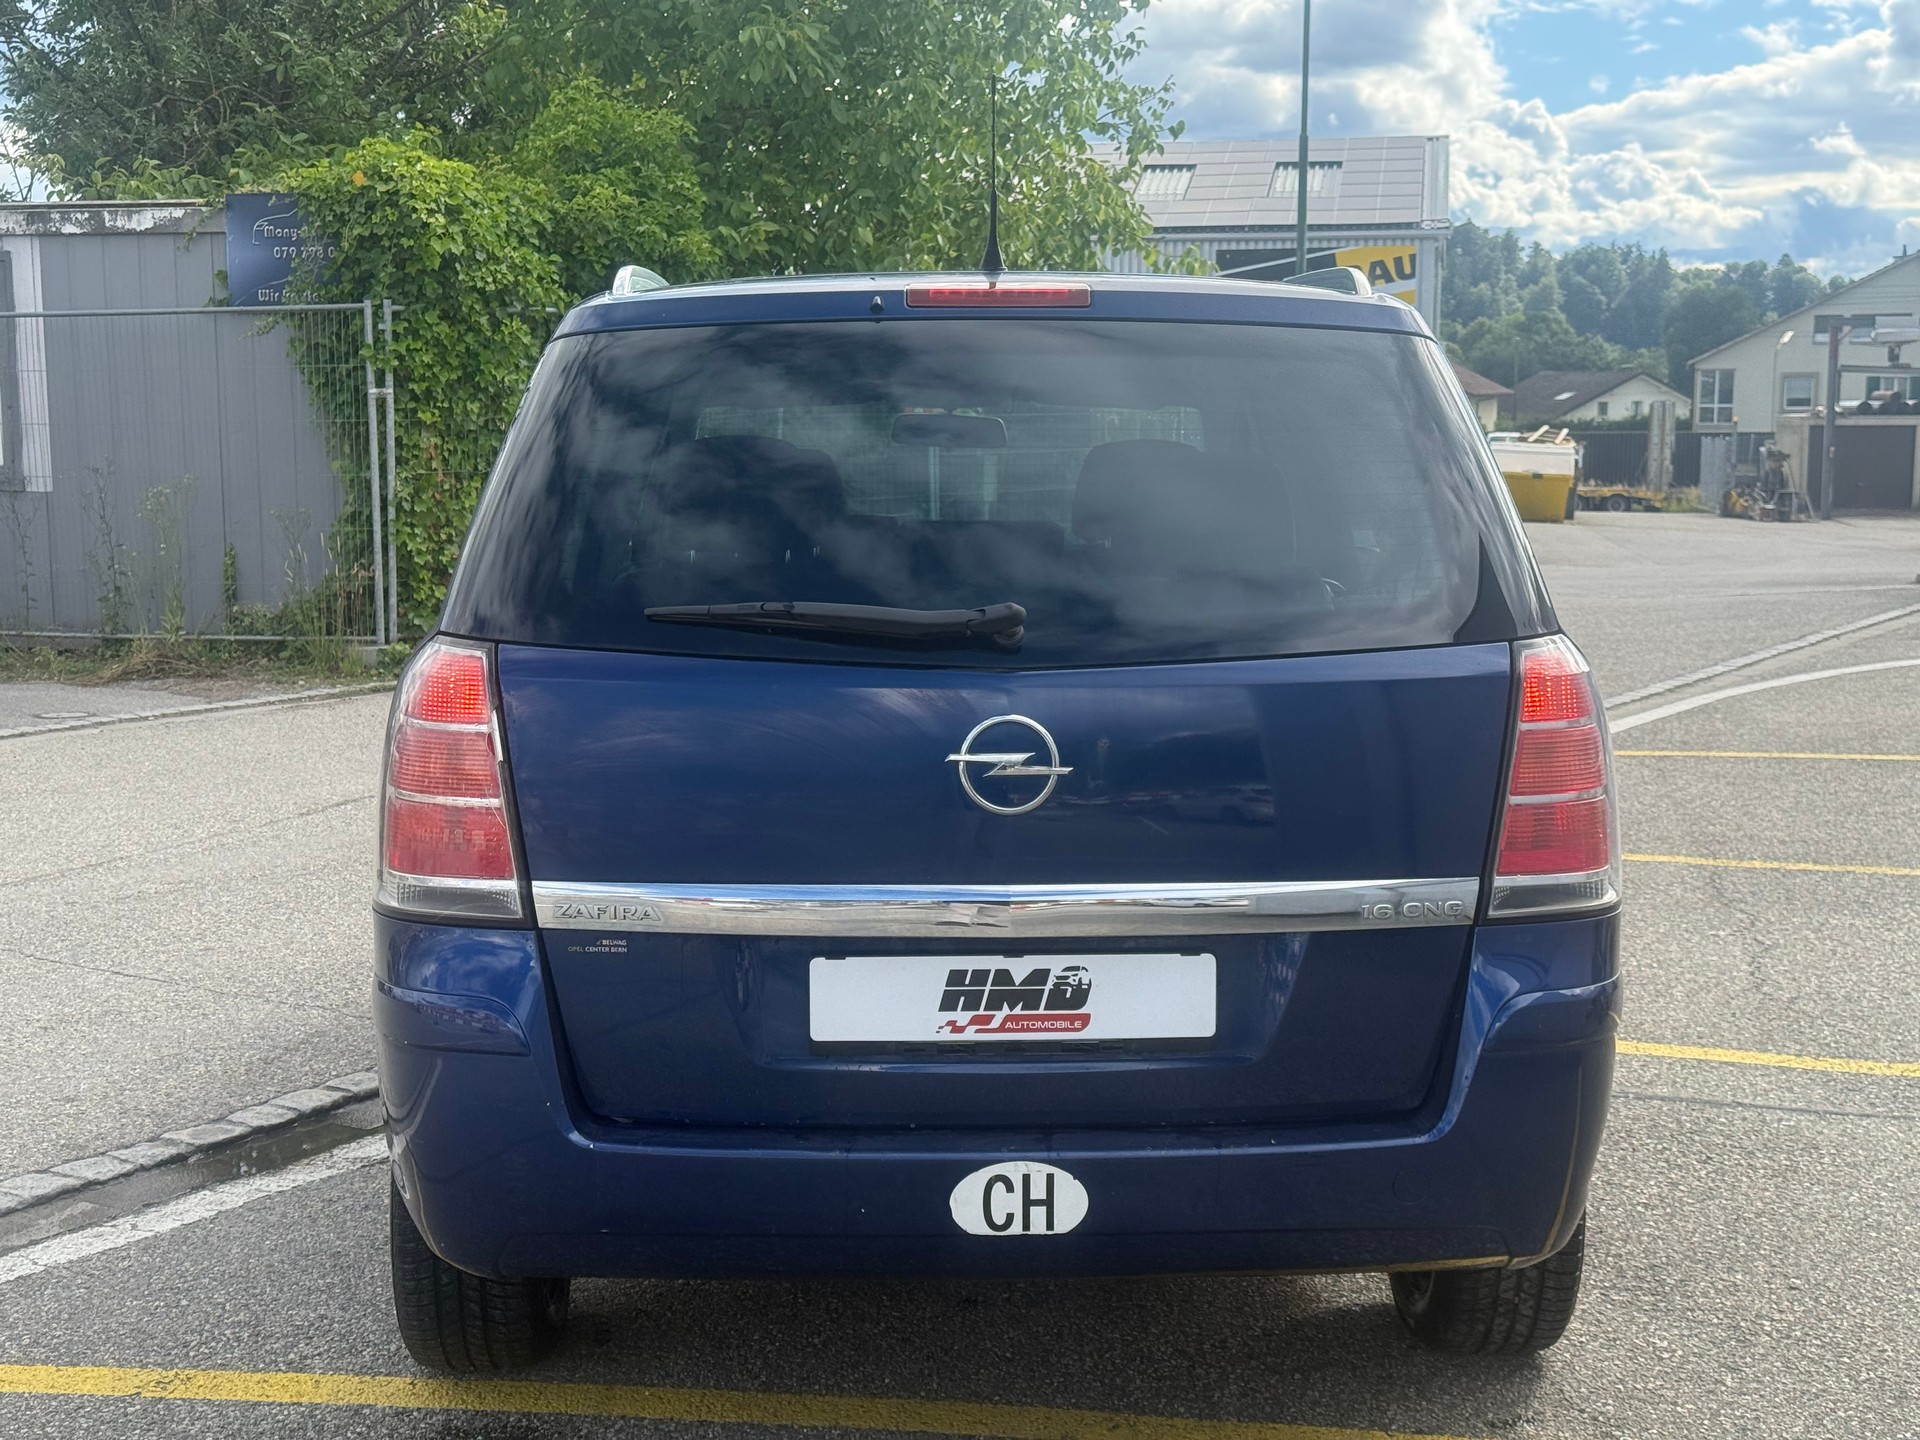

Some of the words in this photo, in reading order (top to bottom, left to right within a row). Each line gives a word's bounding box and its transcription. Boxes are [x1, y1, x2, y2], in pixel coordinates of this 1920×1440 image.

[264, 225, 301, 241] Mony-
[273, 246, 296, 258] 079
[328, 246, 336, 258] 0
[1346, 253, 1417, 287] AU
[258, 289, 280, 302] Wir
[554, 902, 661, 921] ZAFIRA
[1402, 900, 1464, 919] CNG
[1004, 1020, 1083, 1030] AUTOMOBILE
[983, 1173, 1055, 1233] CH
